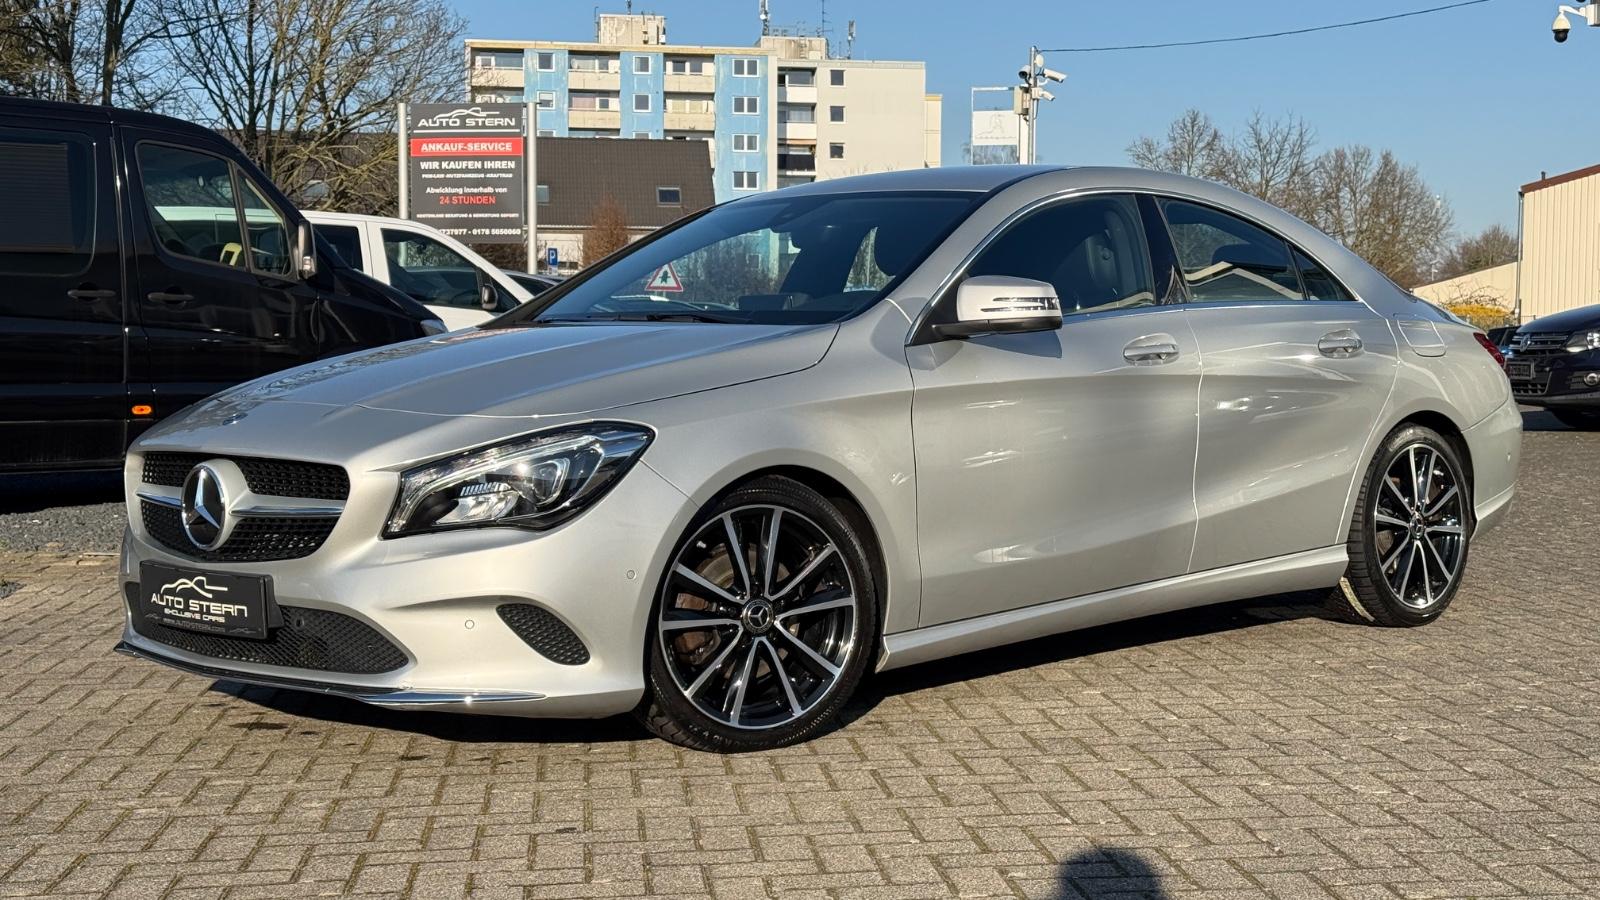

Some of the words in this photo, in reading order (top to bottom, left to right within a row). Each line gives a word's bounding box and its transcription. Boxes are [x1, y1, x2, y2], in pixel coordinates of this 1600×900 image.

[417, 118, 460, 127] AUTO
[465, 117, 516, 127] STERN
[421, 142, 513, 152] ANKAUF-SERVICE
[420, 161, 440, 170] WIR
[441, 161, 482, 170] KAUFEN
[483, 160, 516, 169] IHREN
[425, 186, 463, 195] Abwicklung
[463, 186, 495, 194] innerhalb
[439, 195, 450, 205] 24
[451, 195, 497, 205] STUNDEN
[550, 250, 556, 264] P
[151, 592, 184, 609] AUTO
[189, 600, 248, 618] STERN
[164, 608, 201, 620] EXCLUSIVE
[202, 614, 226, 623] CARS
